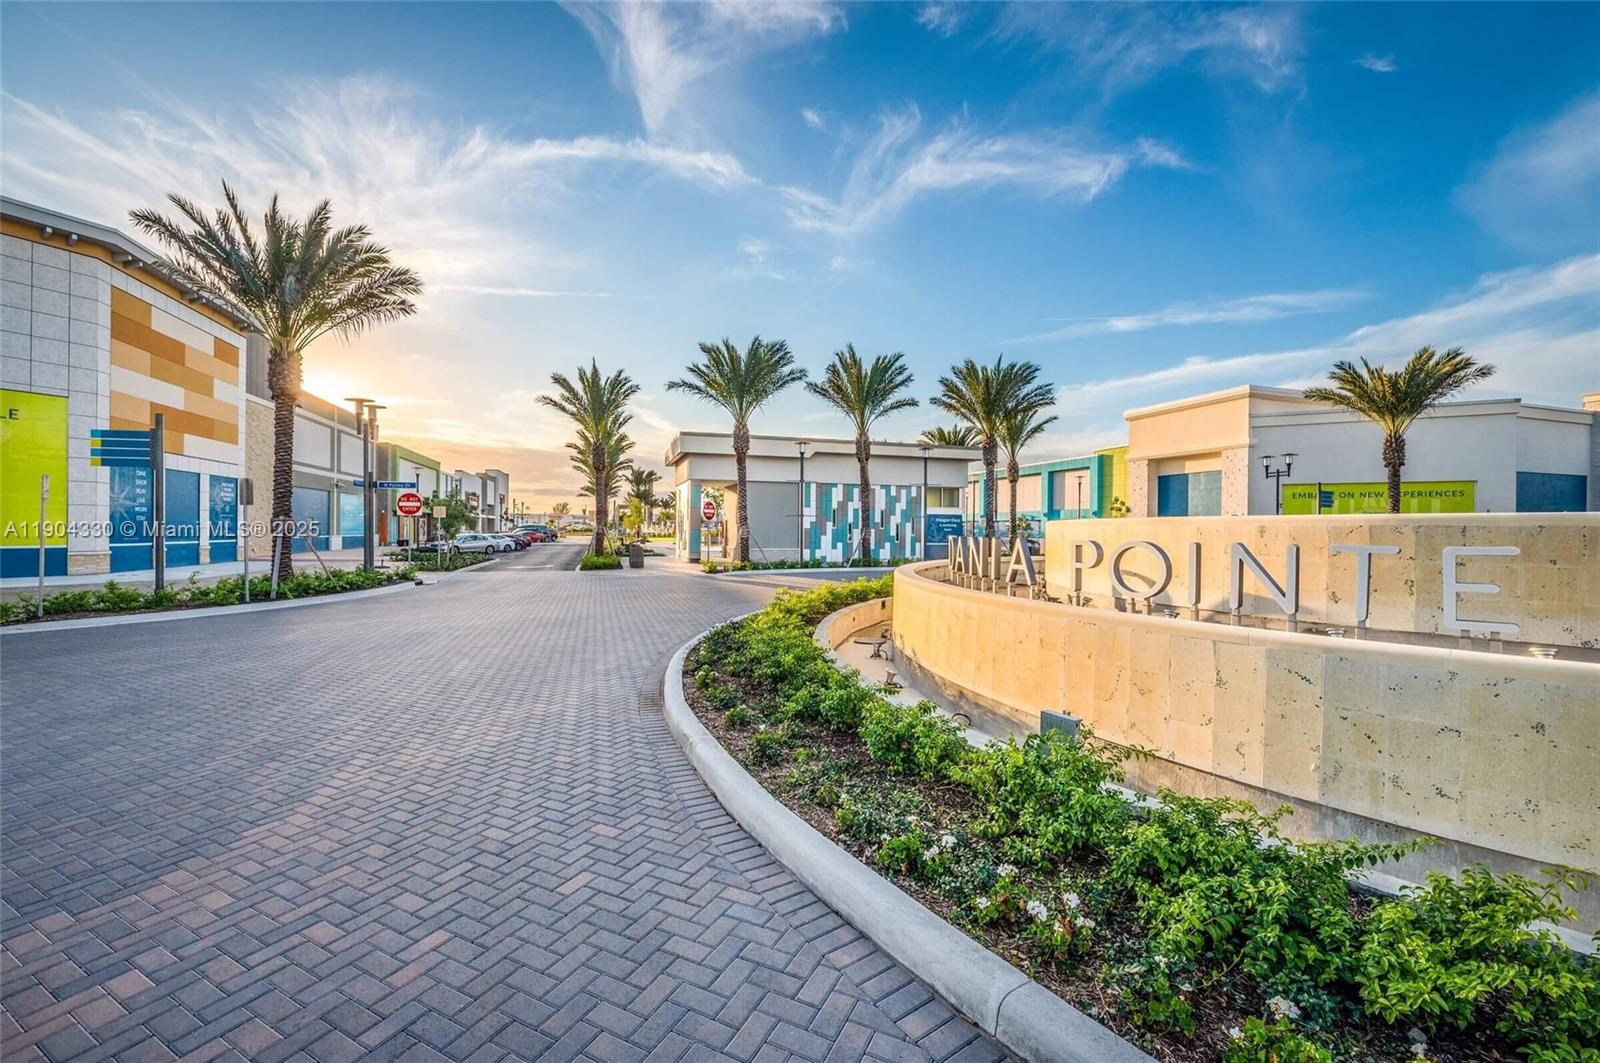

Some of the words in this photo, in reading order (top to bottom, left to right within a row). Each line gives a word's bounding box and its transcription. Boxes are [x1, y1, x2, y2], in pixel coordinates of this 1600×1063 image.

[1338, 491, 1355, 499] ON
[1399, 489, 1465, 498] PERIENCES
[948, 535, 1037, 586] DANIA
[1072, 540, 1521, 635] POINTE
